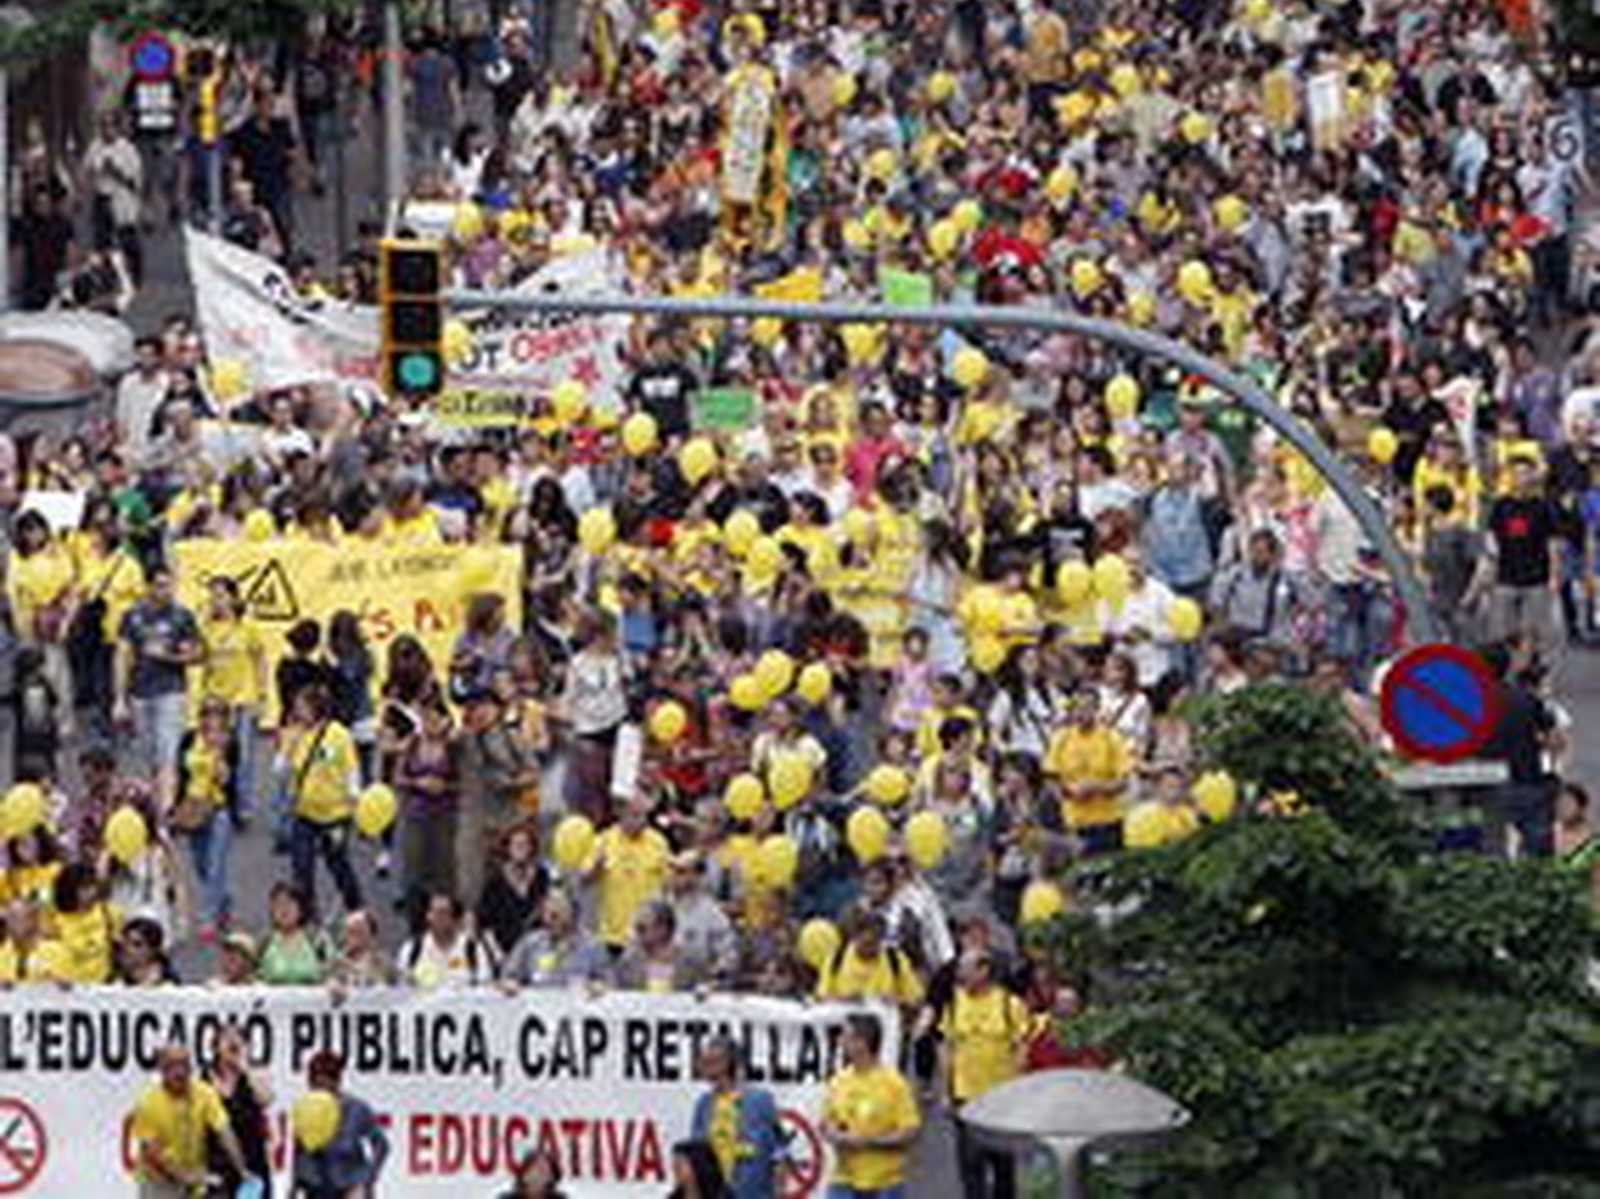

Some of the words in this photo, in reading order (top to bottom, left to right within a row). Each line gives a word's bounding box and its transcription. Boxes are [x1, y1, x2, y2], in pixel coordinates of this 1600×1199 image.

[0, 997, 272, 1072] L'EDUCACÓ
[518, 1013, 608, 1079] CAP
[624, 1018, 845, 1084] RETLLA
[408, 1113, 665, 1182] EDUCATIVA
